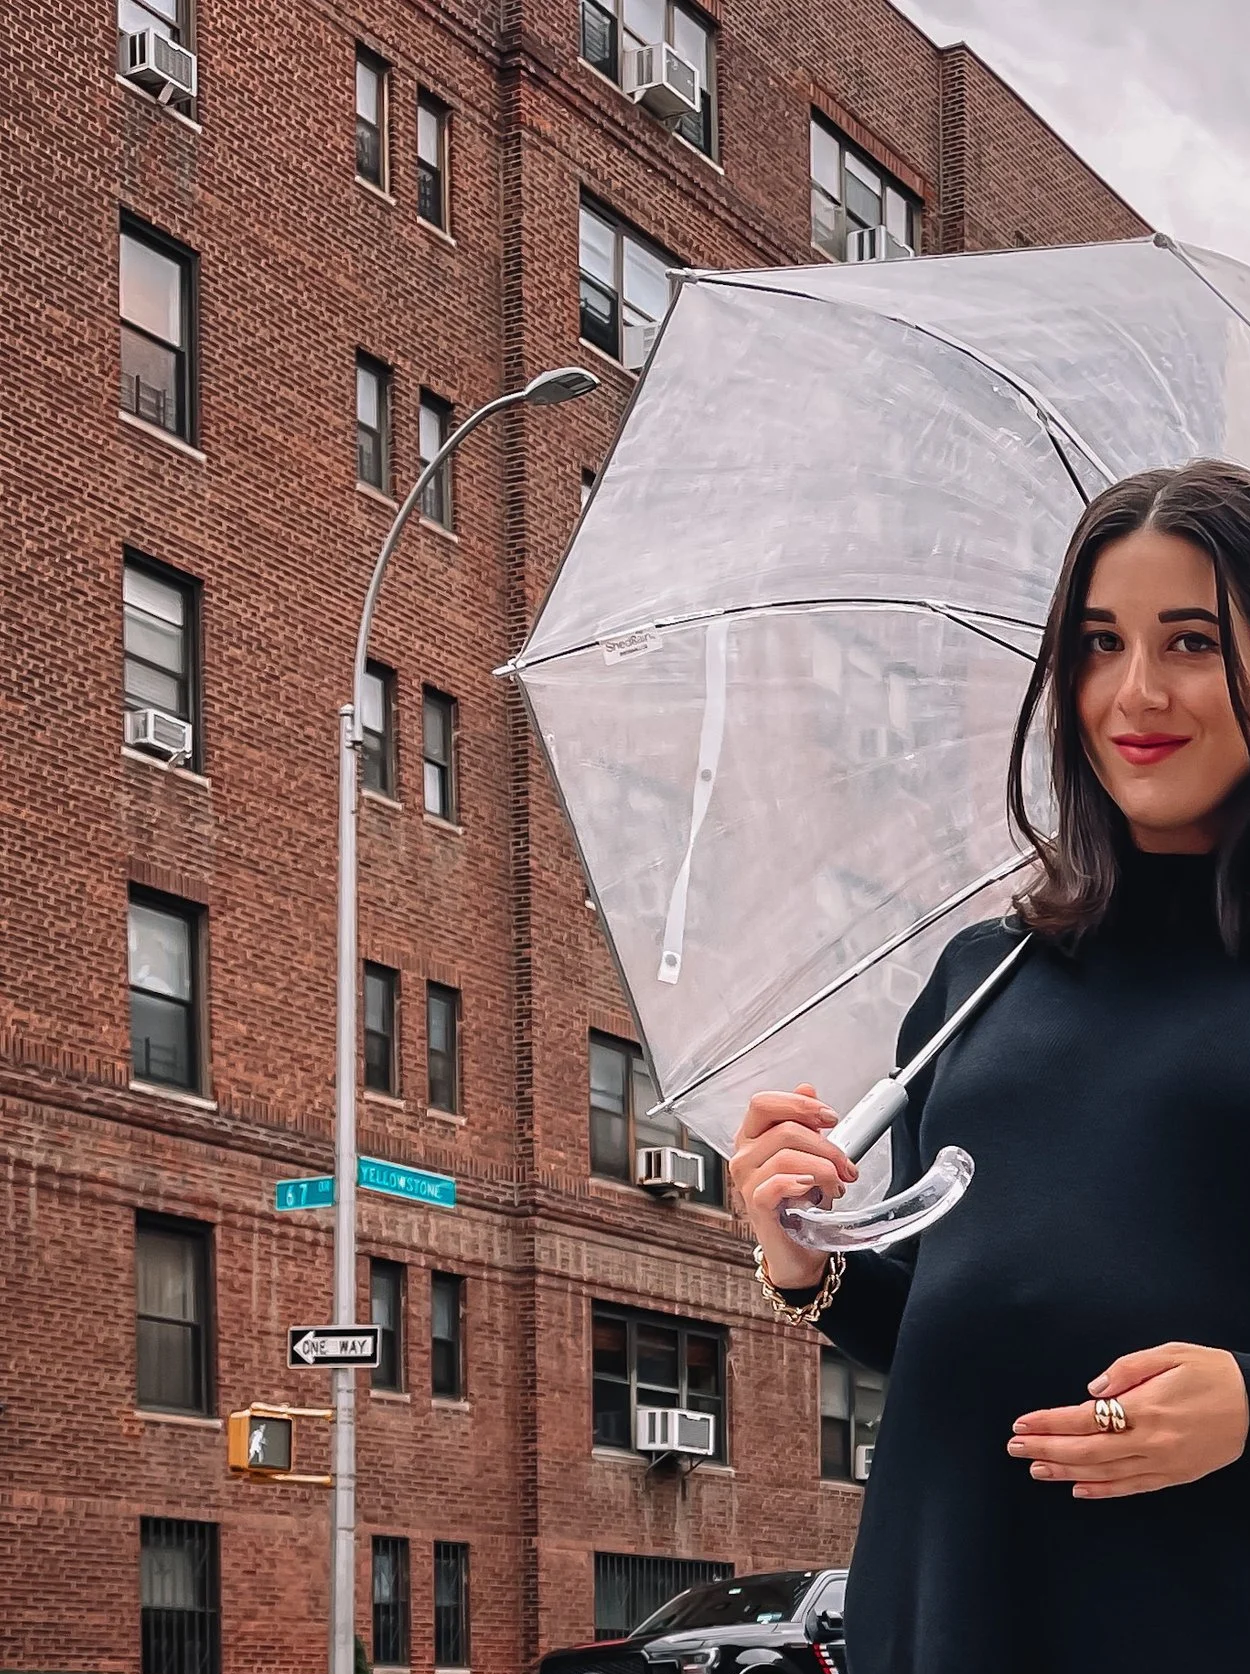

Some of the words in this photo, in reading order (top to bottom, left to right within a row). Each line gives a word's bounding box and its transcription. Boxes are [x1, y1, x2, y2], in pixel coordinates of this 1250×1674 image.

[360, 1165, 443, 1199] YELLOWSTONE
[286, 1183, 308, 1207] 67
[302, 1340, 327, 1355] ONE
[339, 1340, 367, 1355] WAY
